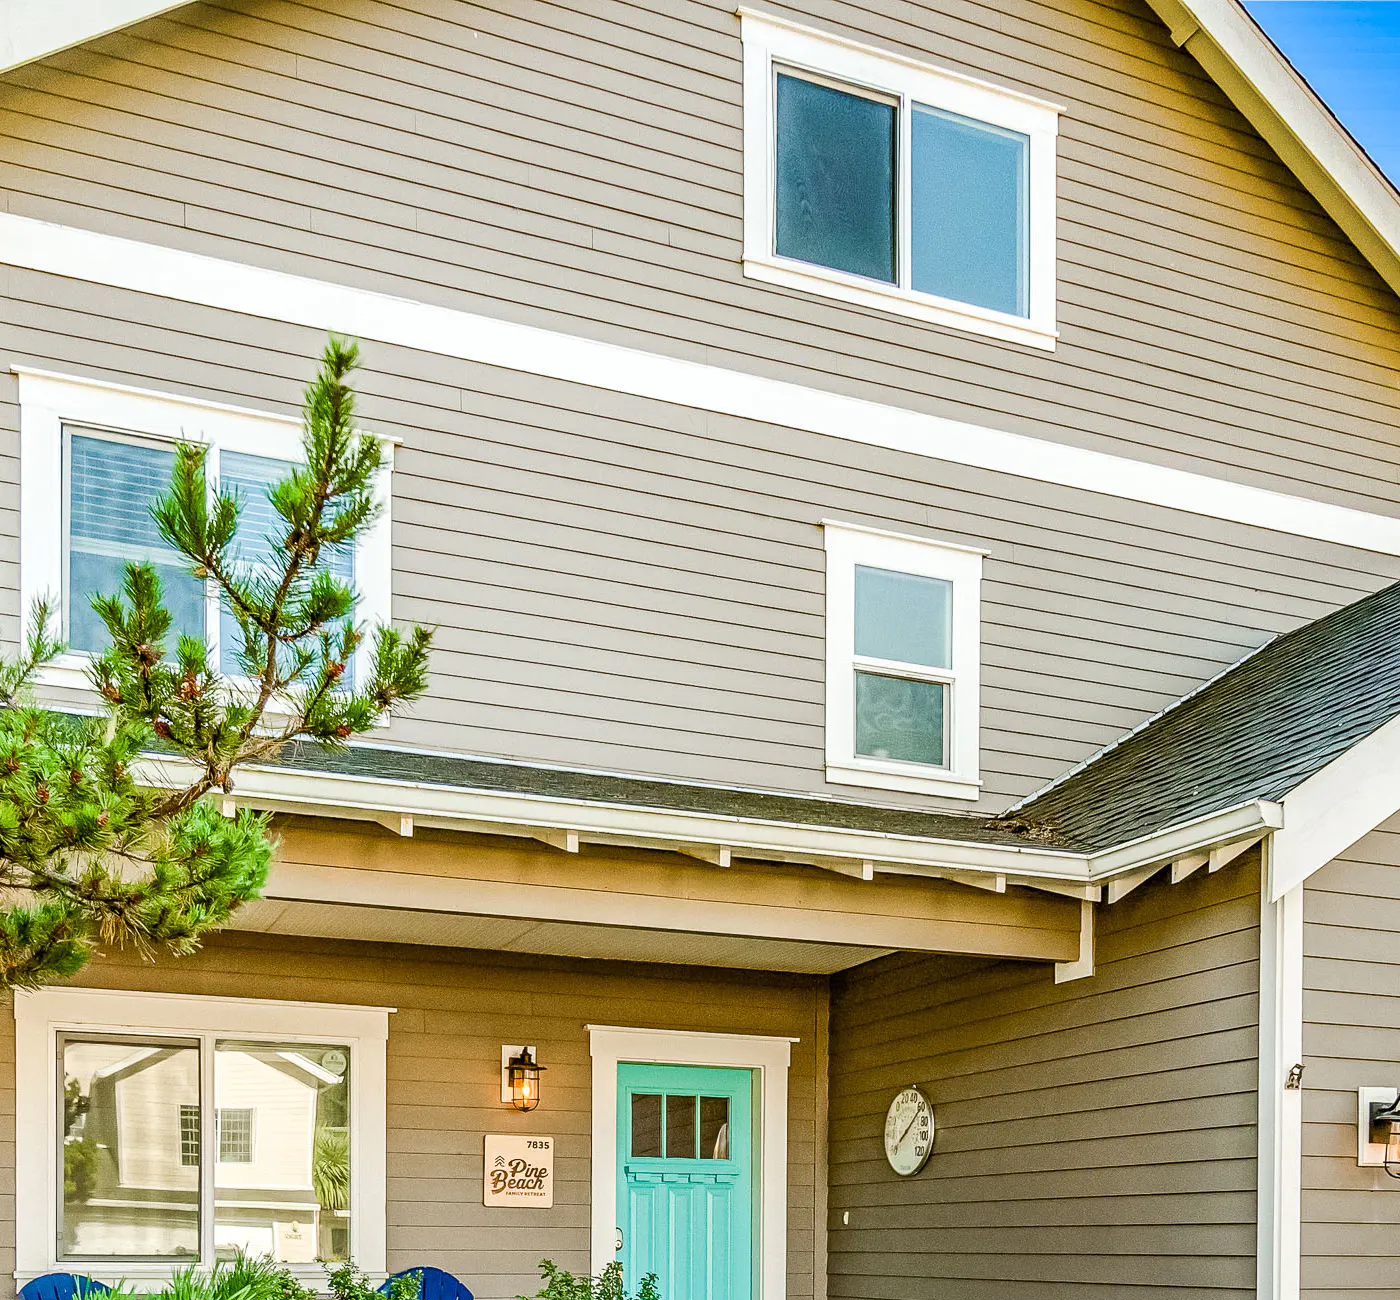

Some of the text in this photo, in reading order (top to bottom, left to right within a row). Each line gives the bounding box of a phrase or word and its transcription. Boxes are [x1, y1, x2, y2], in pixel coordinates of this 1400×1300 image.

[901, 1093, 909, 1103] 20
[910, 1093, 918, 1103] 40
[920, 1116, 928, 1127] 80
[919, 1131, 928, 1141] 100
[526, 1141, 550, 1149] 7835
[914, 1145, 925, 1156] 120
[508, 1158, 548, 1178] Pine
[490, 1169, 544, 1195] Beach
